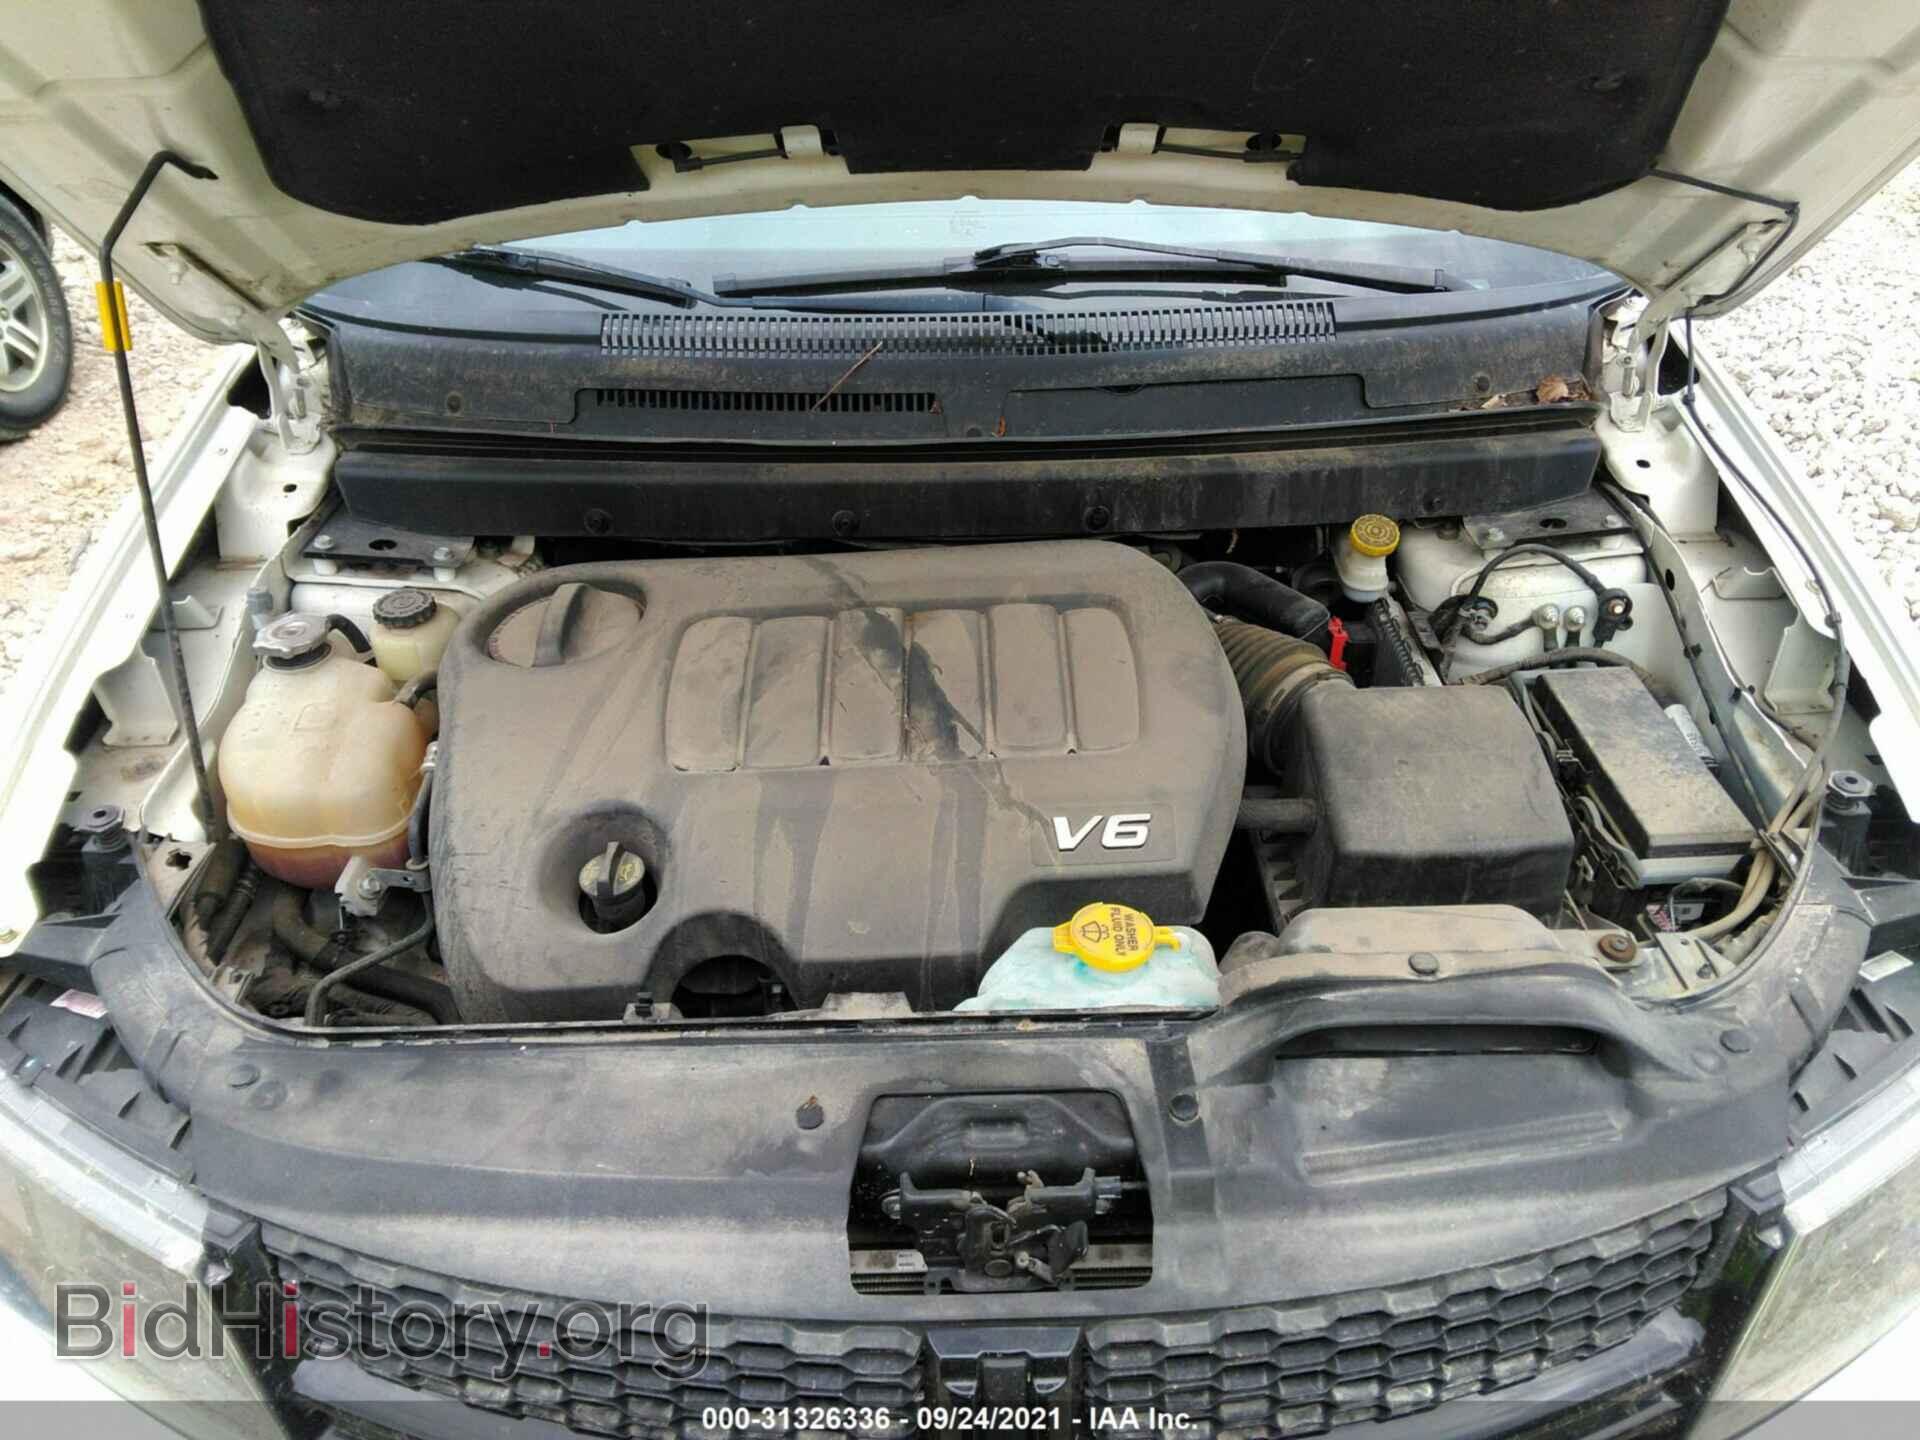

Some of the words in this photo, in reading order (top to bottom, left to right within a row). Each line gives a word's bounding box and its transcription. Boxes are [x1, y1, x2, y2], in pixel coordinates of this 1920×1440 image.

[1053, 813, 1151, 851] V6
[1110, 907, 1125, 933] FLUID
[1124, 912, 1139, 951] WASHER
[1114, 932, 1127, 956] ONLY
